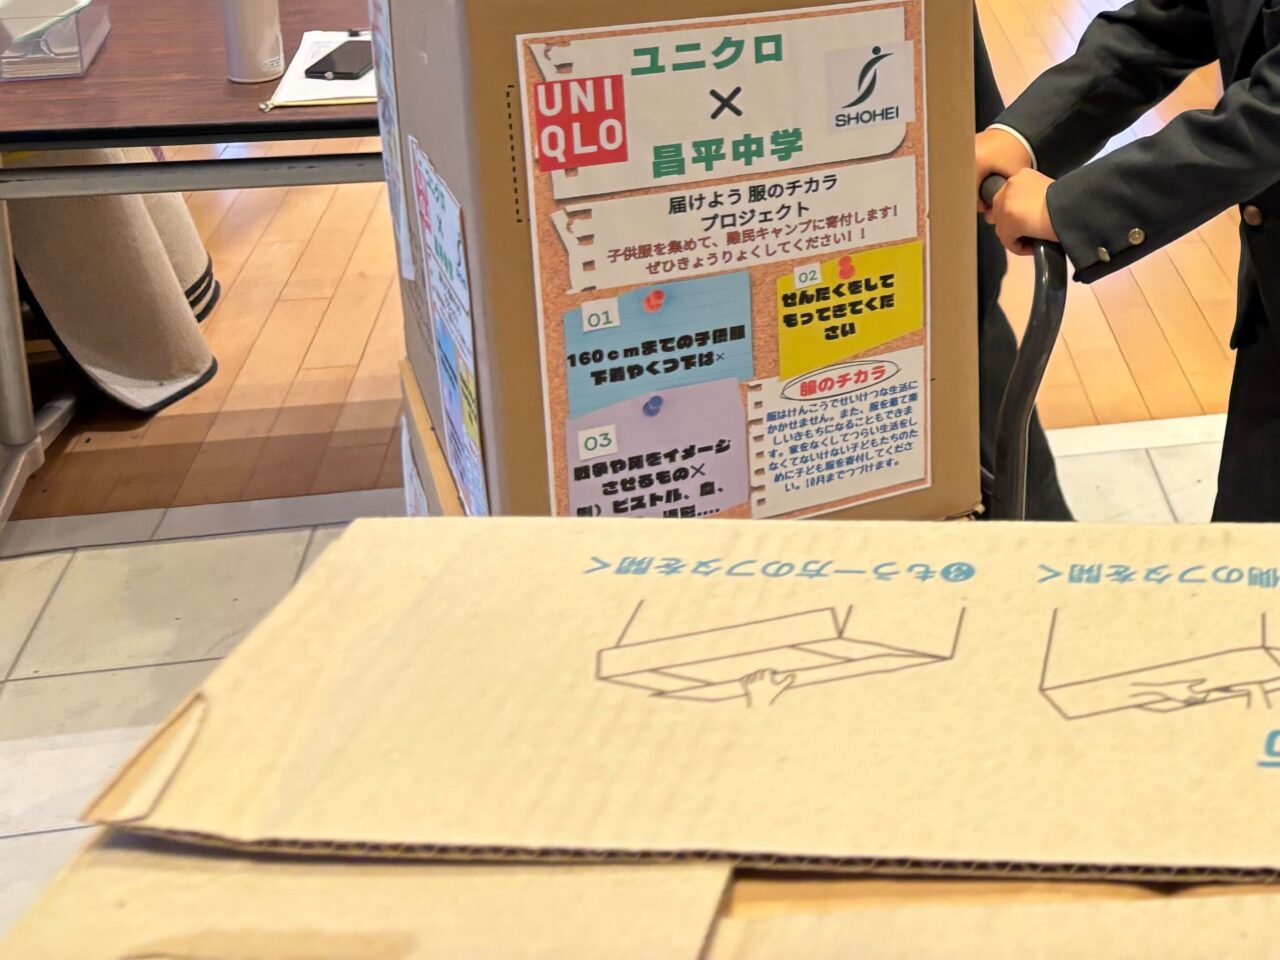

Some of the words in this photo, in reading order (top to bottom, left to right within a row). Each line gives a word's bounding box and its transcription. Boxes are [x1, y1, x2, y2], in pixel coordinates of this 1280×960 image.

[631, 33, 783, 76] ユニクロ
[537, 77, 614, 117] UNI
[835, 106, 899, 128] SHOHEI
[539, 118, 624, 162] QLO
[652, 127, 803, 179] 昌平中学
[668, 188, 741, 215] 届けよう
[748, 174, 838, 204] 服のチカラ
[701, 201, 810, 232] プロジェクト
[782, 273, 895, 308] せんたくをして
[798, 270, 818, 283] 02
[587, 310, 613, 328] 01
[783, 293, 895, 328] もってきてくだ
[824, 322, 856, 341] さい
[800, 365, 887, 397] 服のチカラ
[584, 432, 612, 451] 03
